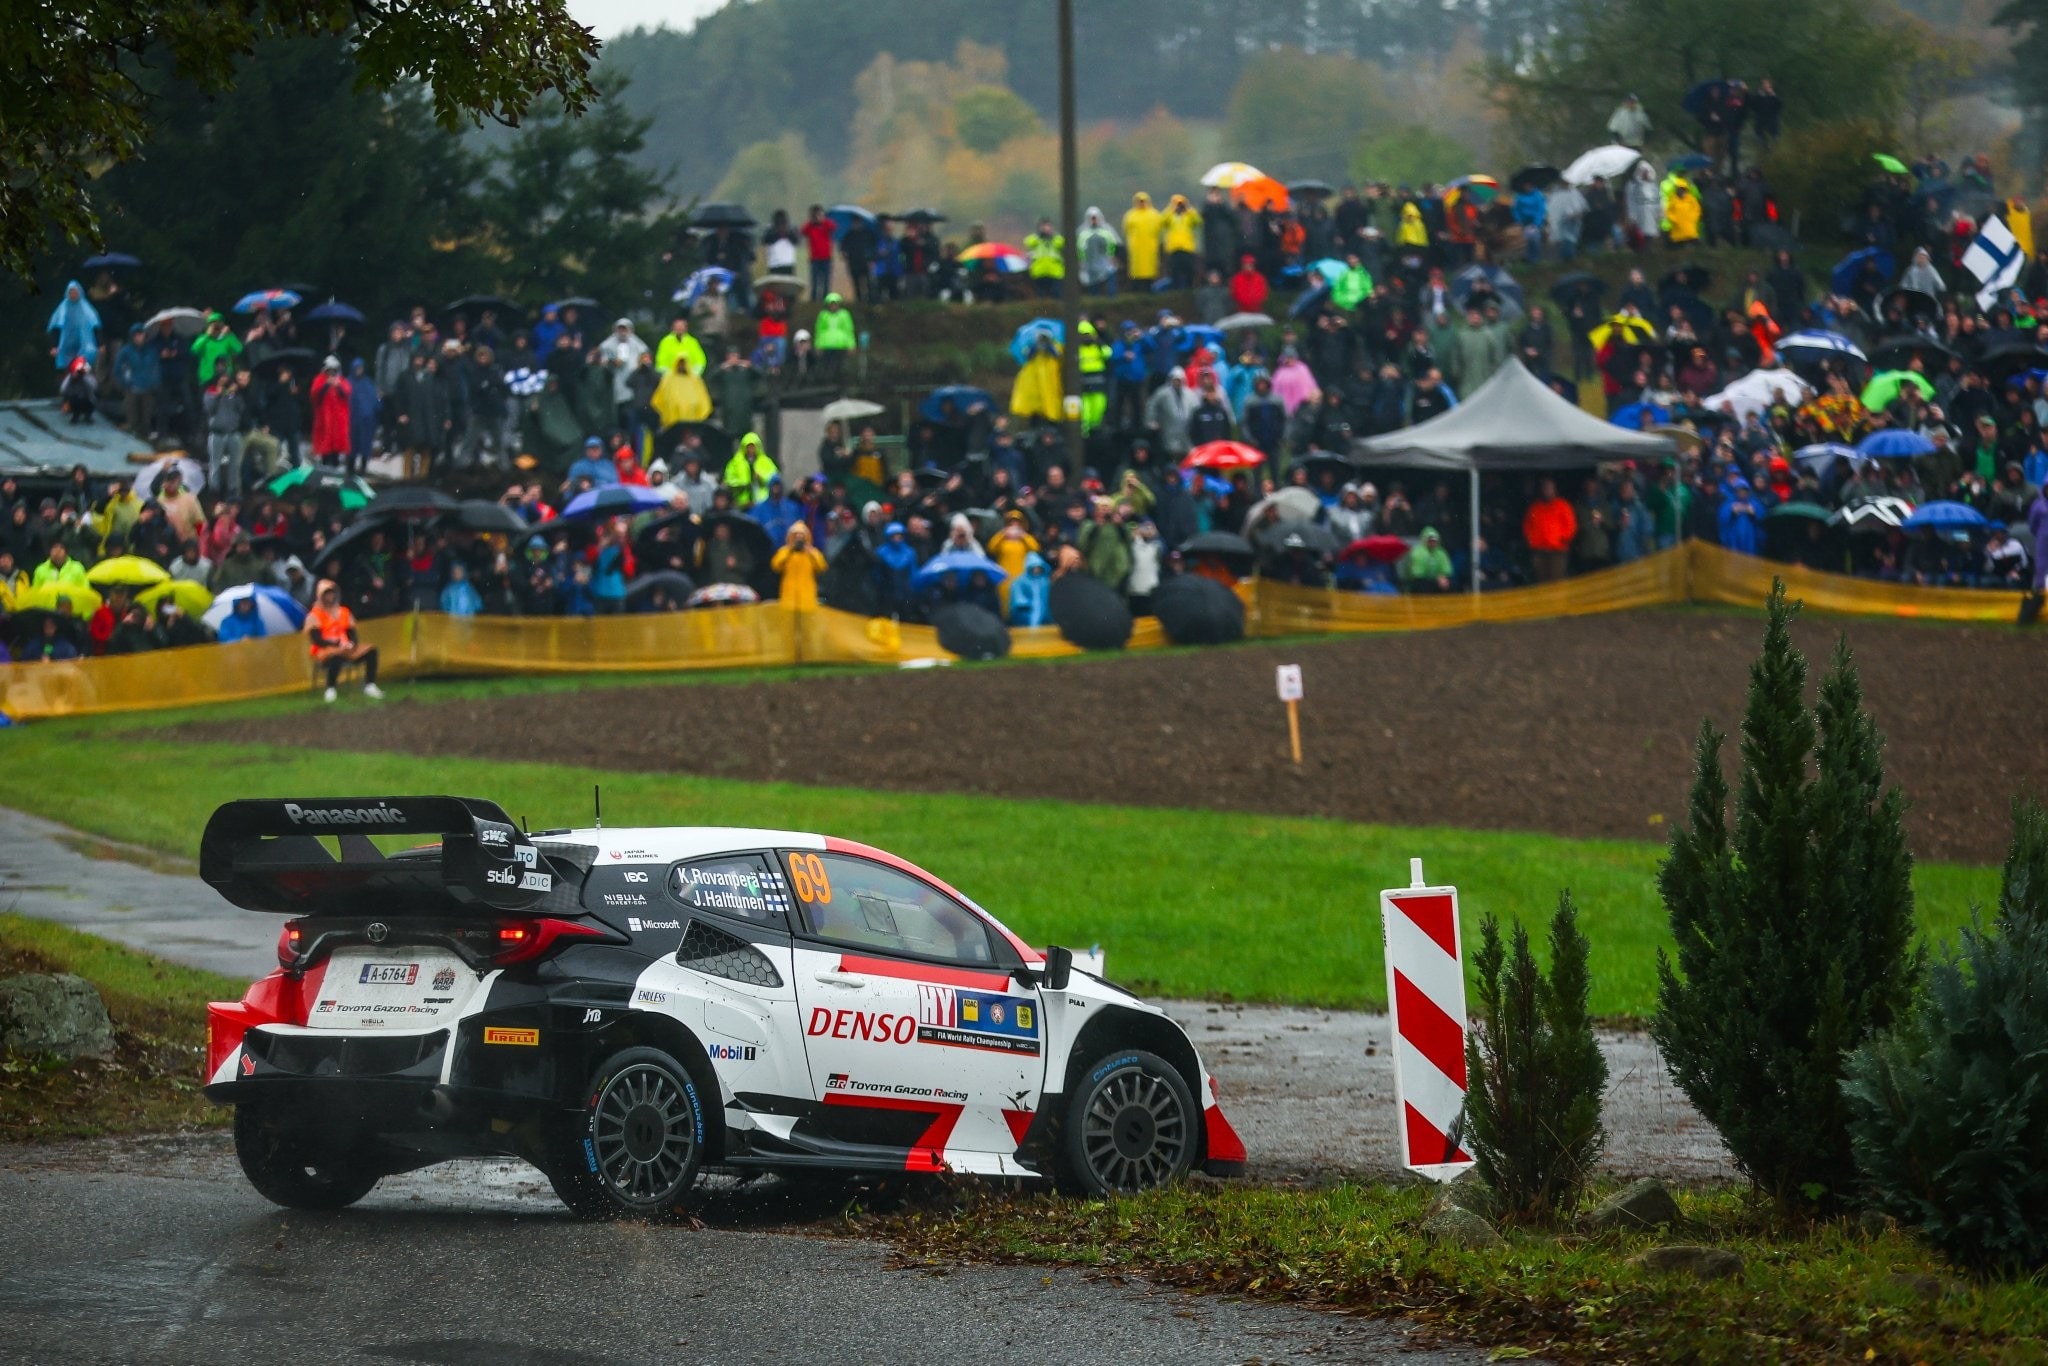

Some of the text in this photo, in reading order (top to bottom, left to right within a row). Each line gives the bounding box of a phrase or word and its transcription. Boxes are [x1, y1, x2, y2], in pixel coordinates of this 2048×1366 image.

[284, 802, 407, 825] Panasonic
[487, 865, 516, 885] Stilo
[788, 852, 833, 904] 69
[603, 893, 646, 901] NISULA
[694, 889, 766, 911] J.Halttunen
[642, 919, 681, 929] Microsoft
[638, 991, 666, 1003] ENDLESS
[963, 1000, 978, 1008] ADAC
[1068, 998, 1086, 1008] PIAA
[337, 1004, 371, 1013] TOYOTA
[373, 1004, 406, 1013] GAZOO
[407, 1005, 439, 1016] Racing
[807, 1007, 917, 1045] DENSO
[488, 1029, 535, 1043] PIRELLI
[937, 1031, 946, 1039] FIA
[947, 1032, 962, 1041] World
[963, 1034, 976, 1045] Rally
[976, 1036, 1011, 1049] Championship
[710, 1044, 742, 1060] Mobil
[850, 1080, 892, 1093] TOYOTA
[894, 1085, 932, 1096] GAZOO
[934, 1088, 968, 1101] Racing
